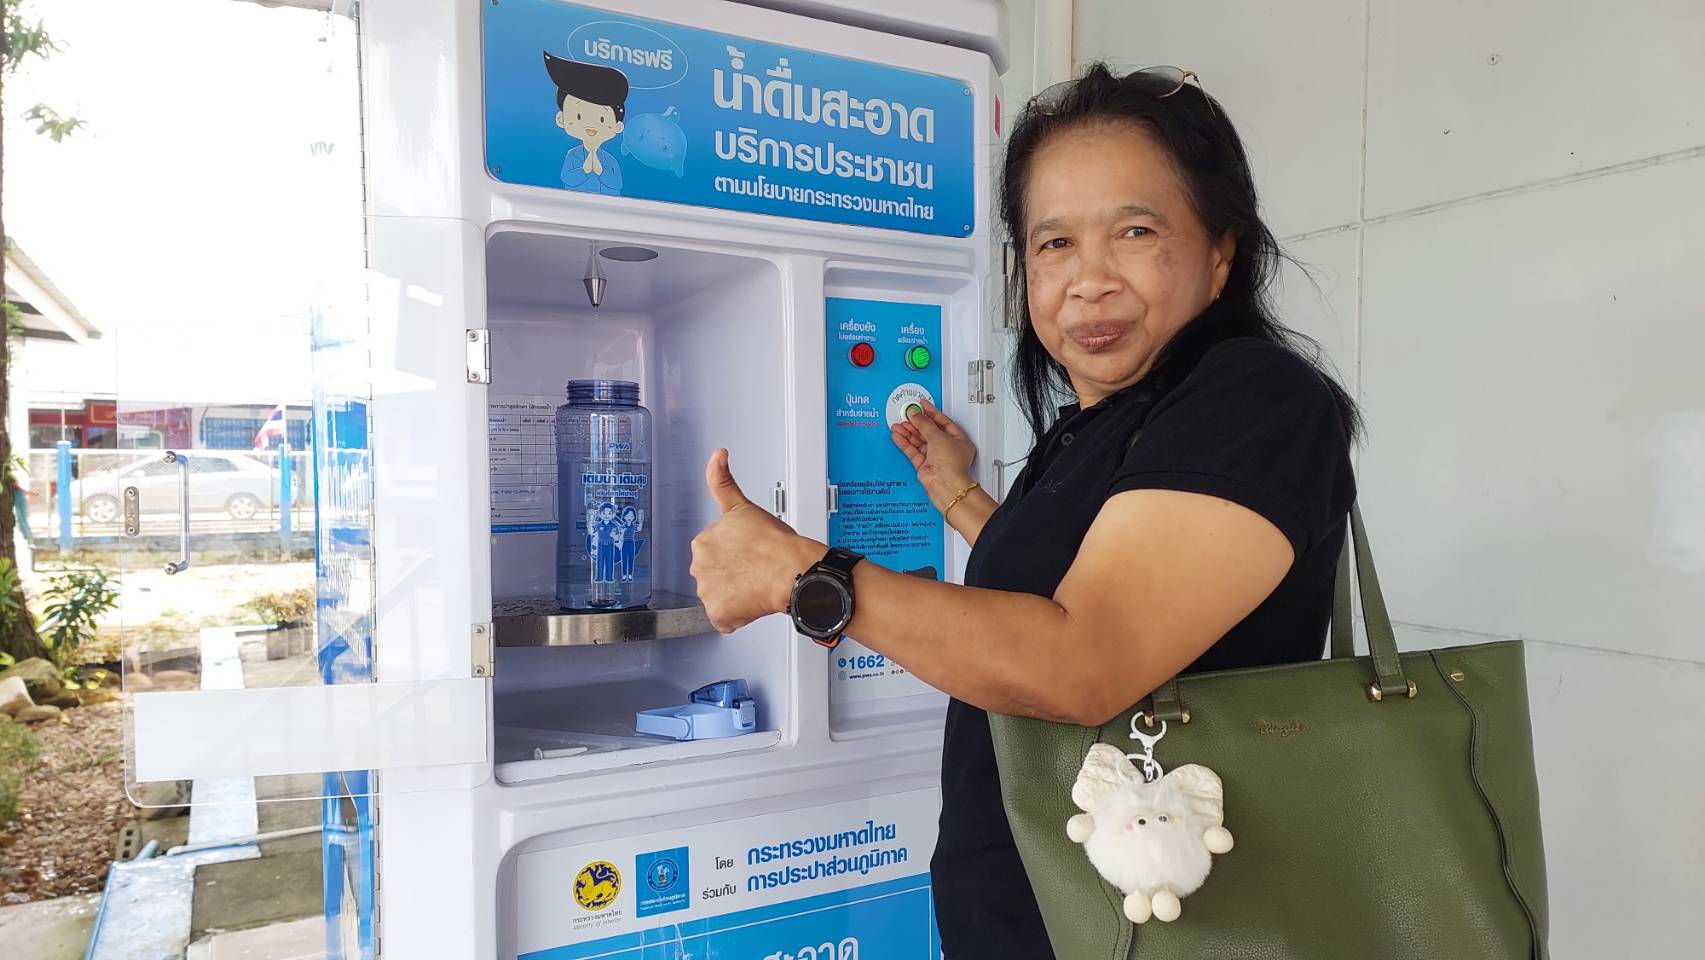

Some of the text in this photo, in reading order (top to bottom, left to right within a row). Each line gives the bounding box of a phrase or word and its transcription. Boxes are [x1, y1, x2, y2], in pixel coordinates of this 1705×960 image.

[584, 38, 673, 71] บริการฟรี
[713, 45, 935, 144] น้ำดื่มสะอาด
[714, 127, 934, 190] บริการประชาชน
[714, 175, 934, 220] ตามนโยบายกระทรวงมหาดไทย
[839, 318, 876, 332] เครื่องยัง
[900, 321, 925, 335] เครื่อง
[846, 393, 870, 407] ปุ่มกด
[836, 407, 879, 418] สำหรับจ่ายน้ำ
[848, 654, 885, 670] 1662
[747, 820, 896, 866] กระทรวงมหาดไทย
[715, 856, 734, 871] โดย
[747, 847, 908, 892] การประปาส่วนภูมิภาค
[702, 884, 737, 900] ร่วมกับ
